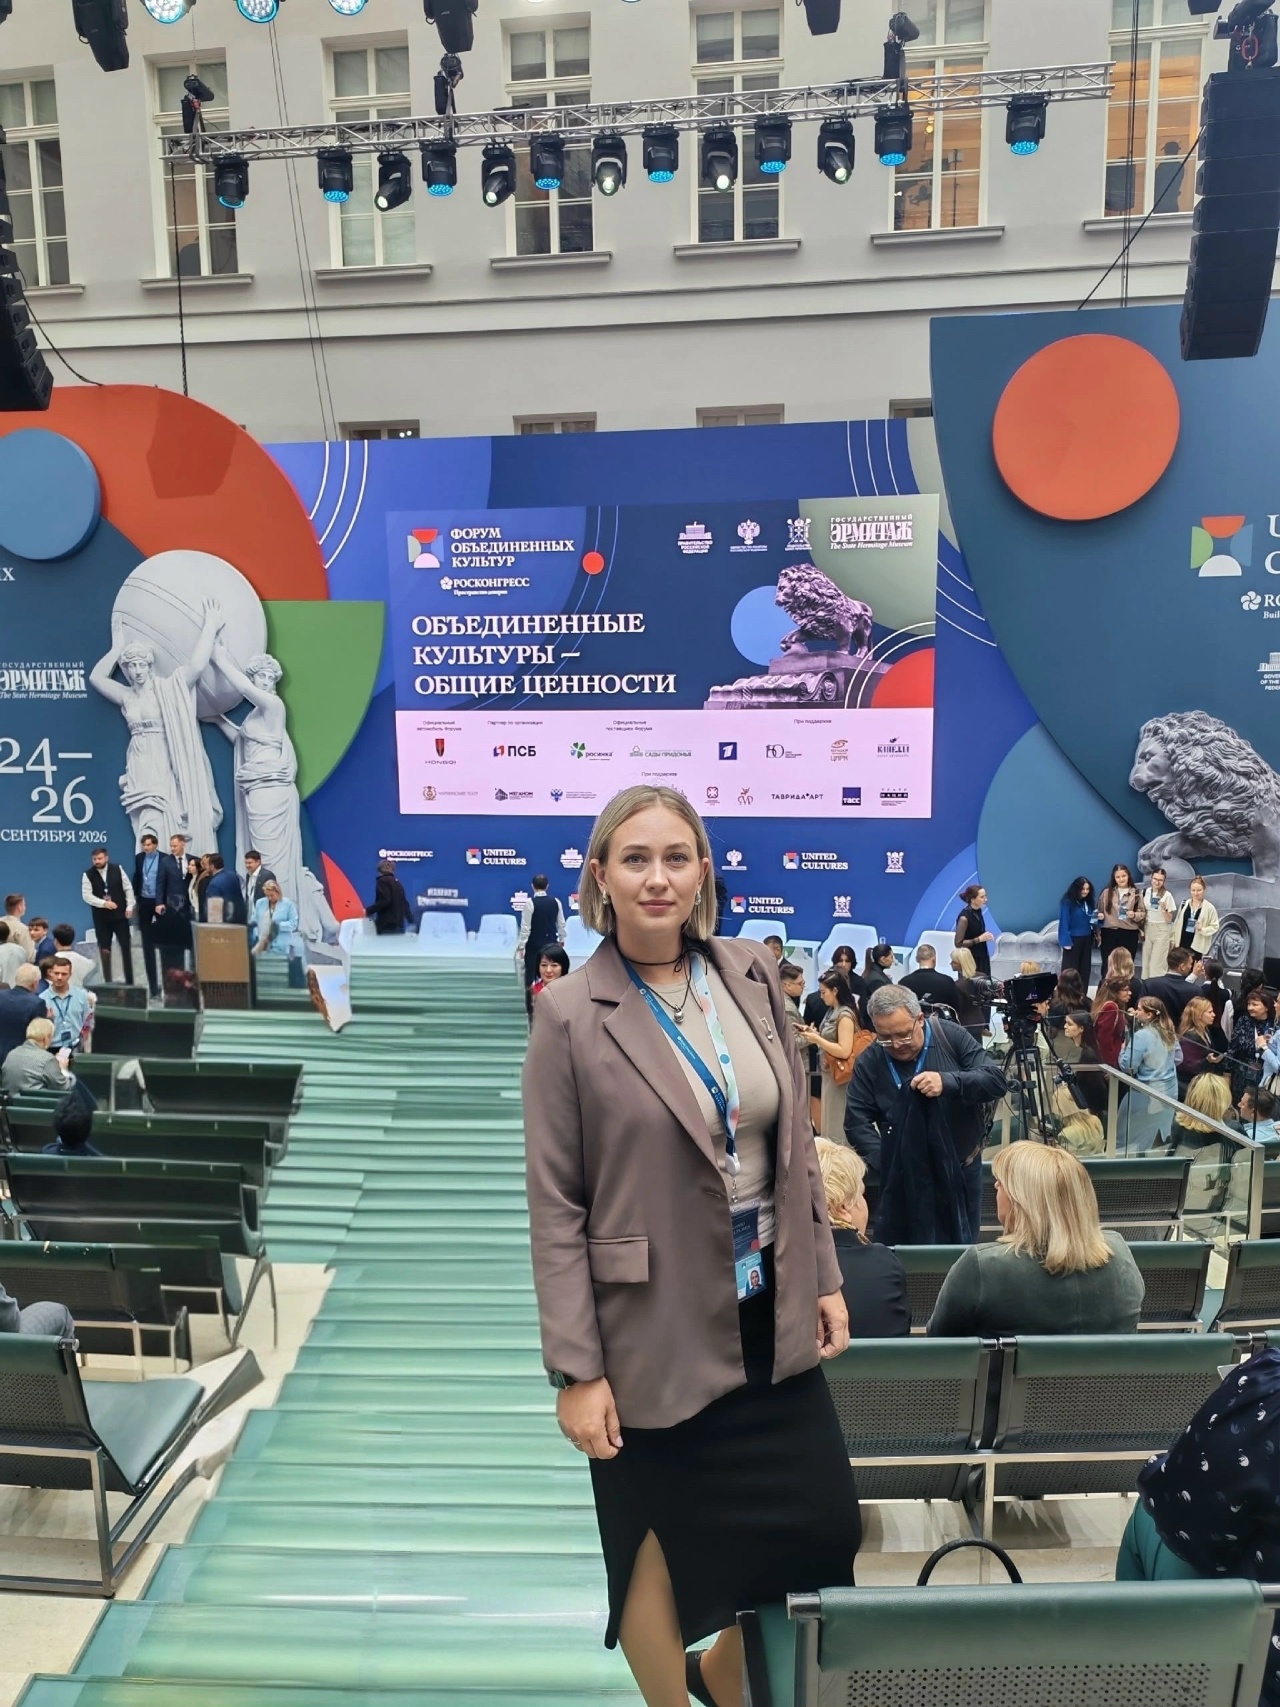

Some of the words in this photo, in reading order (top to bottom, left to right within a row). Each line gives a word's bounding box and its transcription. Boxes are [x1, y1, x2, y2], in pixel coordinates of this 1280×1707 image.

[830, 514, 913, 523] ГОСУДАРСТВЕННЫЙ
[450, 527, 502, 539] ФОРУМ
[830, 521, 913, 543] ЭРМИТАЖ
[450, 540, 575, 554] ОБЪЕДИНЕННЫХ
[857, 540, 888, 550] Hermitage
[452, 556, 516, 568] КУЛЬТУР
[453, 578, 530, 588] РОСКОНГРЕСС
[411, 613, 645, 639] ОБЪЕДИНЕННЫЕ
[413, 645, 555, 665] КУЛЬТУРЫ
[0, 661, 84, 669] ОСУДАРСТВЕННЫЙ
[0, 669, 87, 691] ЭРМИТАЖ
[414, 675, 517, 698] ОБЩИЕ
[522, 674, 677, 698] ЦЕННОСТИ
[28, 692, 60, 700] Hermitage
[61, 691, 87, 699] Museum
[507, 745, 537, 757] ПСБ
[31, 776, 94, 824] 26
[1, 829, 75, 843] СЕНТЯБРЯ
[79, 830, 107, 843] 2026
[483, 858, 526, 866] CULTURES
[801, 852, 837, 860] UNITED
[801, 861, 848, 870] CULTURES
[748, 897, 783, 905] UNITED
[748, 906, 794, 914] CULTURES
